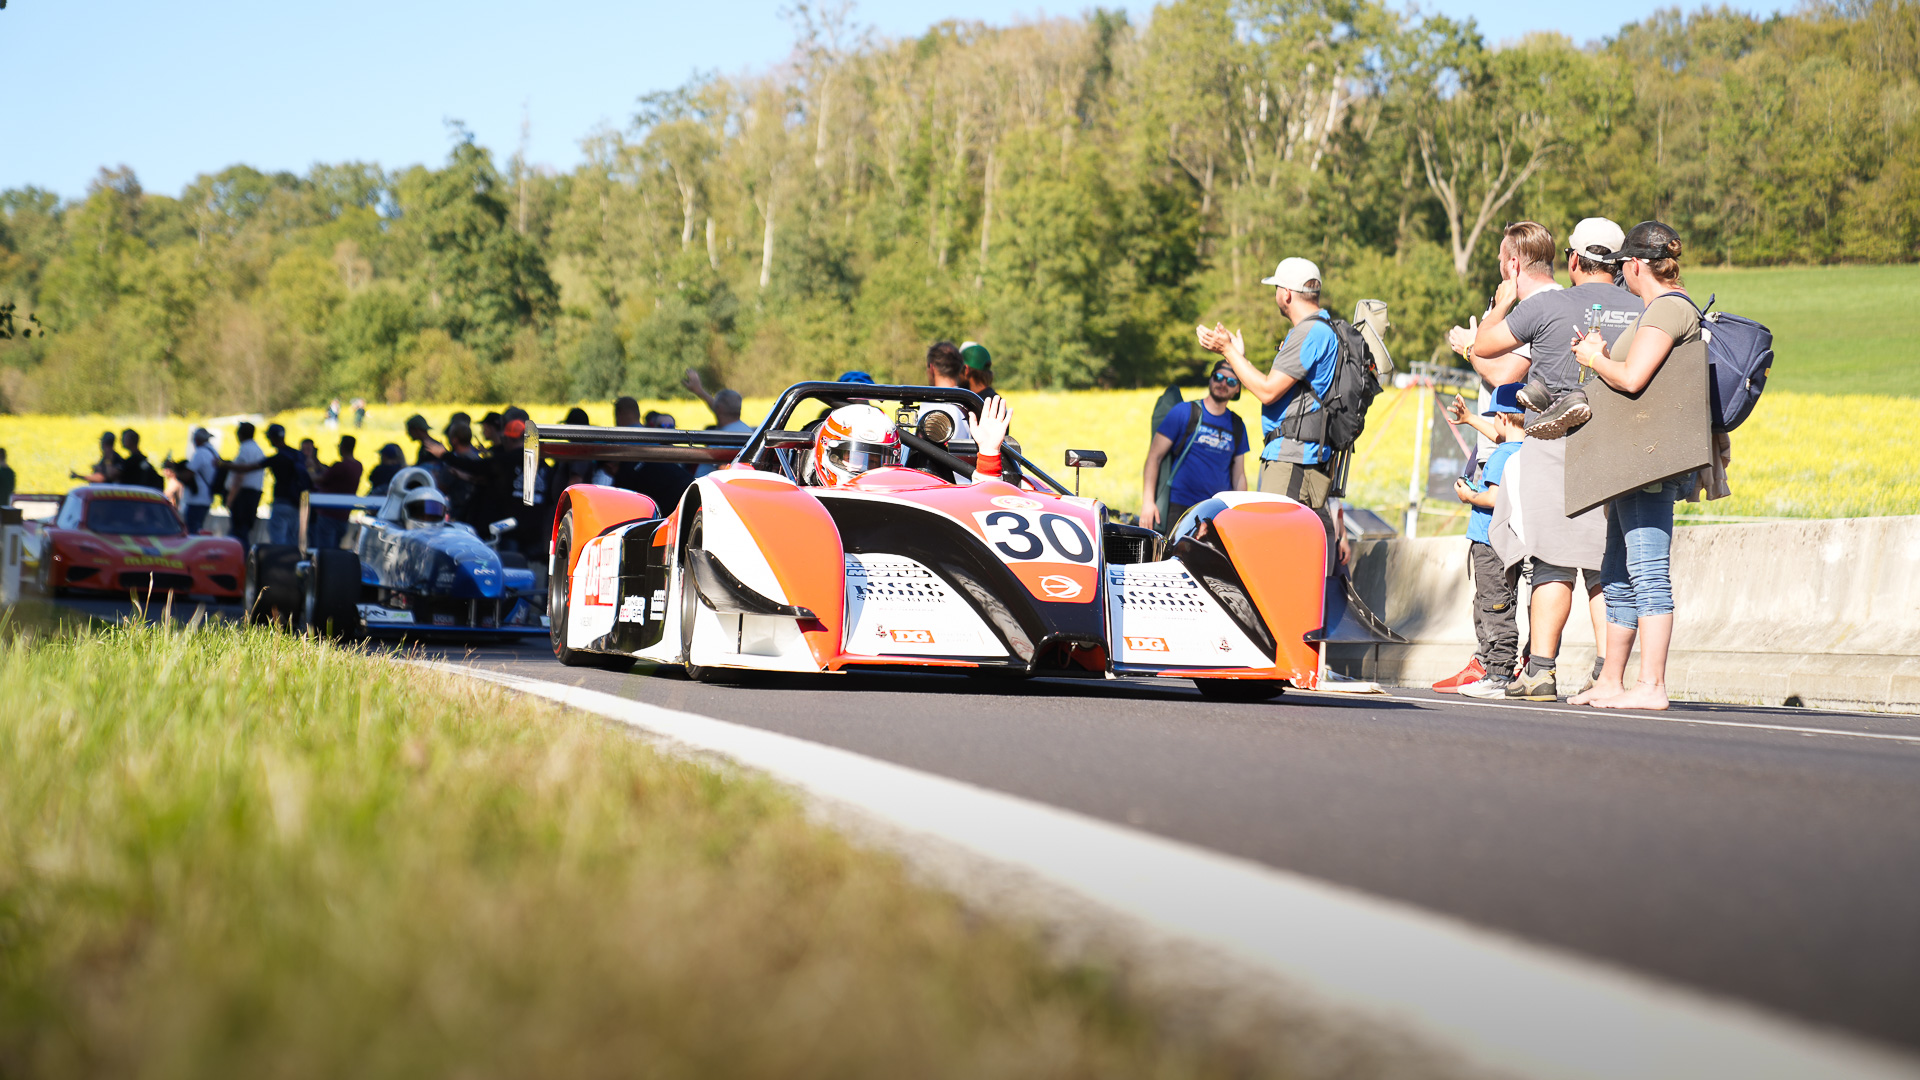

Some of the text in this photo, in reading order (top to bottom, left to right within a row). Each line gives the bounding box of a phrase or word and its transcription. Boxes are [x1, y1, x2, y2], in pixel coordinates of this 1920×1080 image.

[986, 511, 1094, 563] 30
[848, 569, 930, 577] MOTUL
[1115, 578, 1194, 589] MOTUL
[893, 630, 931, 643] DG
[1128, 638, 1166, 651] DG
